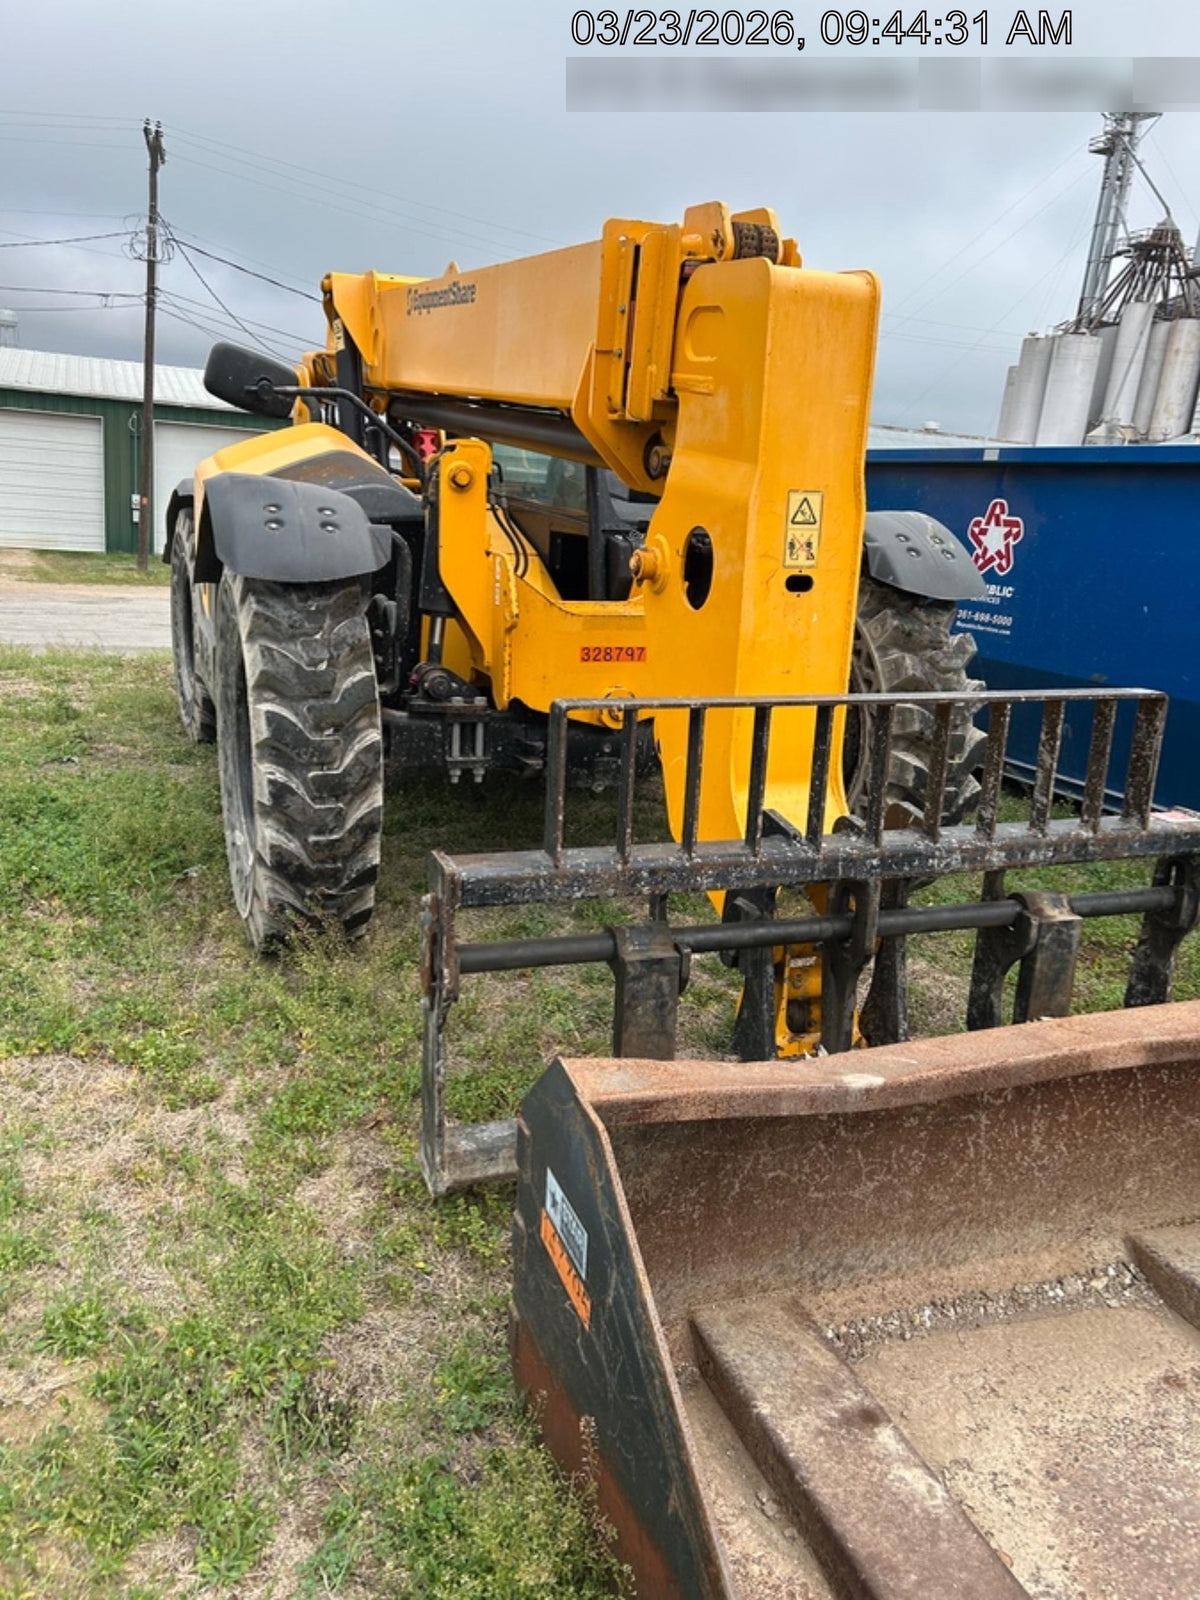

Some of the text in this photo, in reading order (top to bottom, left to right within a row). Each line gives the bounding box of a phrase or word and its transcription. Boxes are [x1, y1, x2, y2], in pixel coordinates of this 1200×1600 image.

[411, 281, 476, 315] EquipmentShare
[985, 584, 1015, 598] BLIC
[581, 646, 646, 662] 328797
